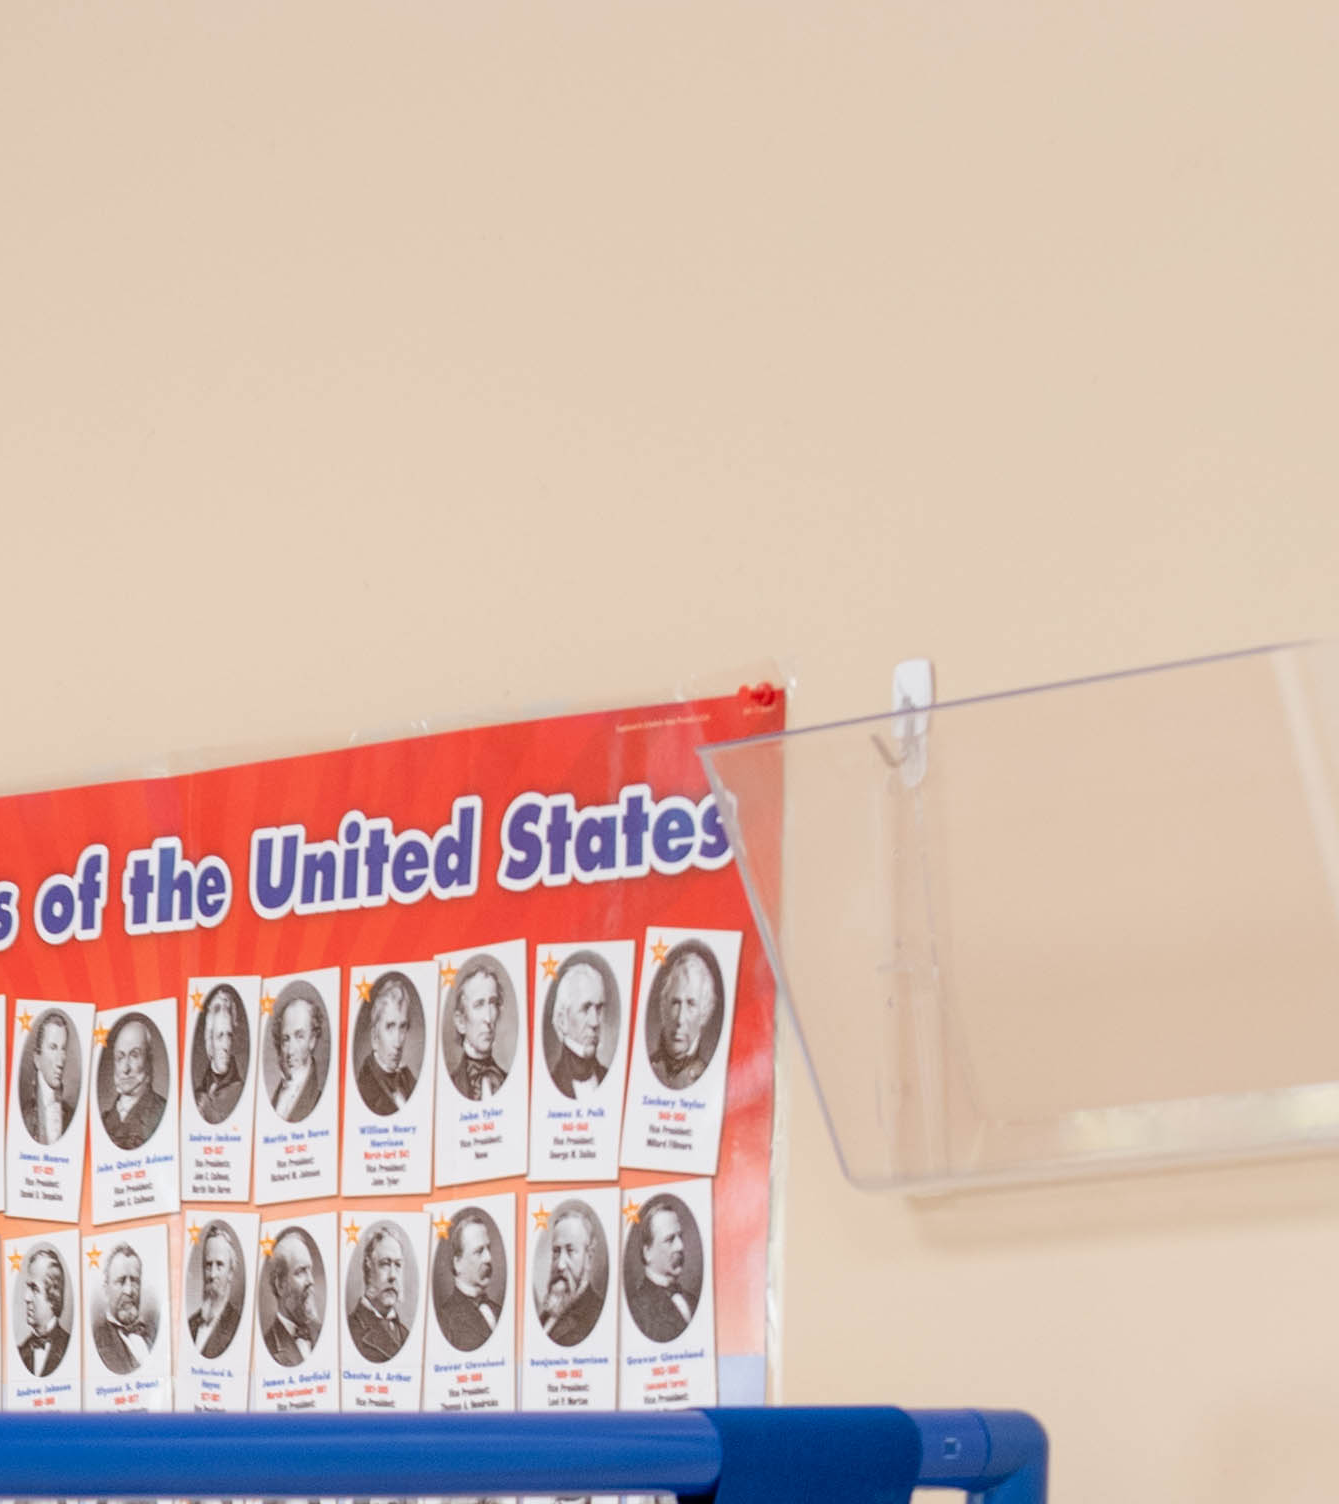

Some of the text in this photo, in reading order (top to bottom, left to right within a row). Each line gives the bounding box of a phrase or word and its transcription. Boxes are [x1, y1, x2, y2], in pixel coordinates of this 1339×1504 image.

[39, 855, 106, 936] of
[128, 845, 229, 929] the
[255, 806, 478, 916] United
[503, 794, 733, 884] States
